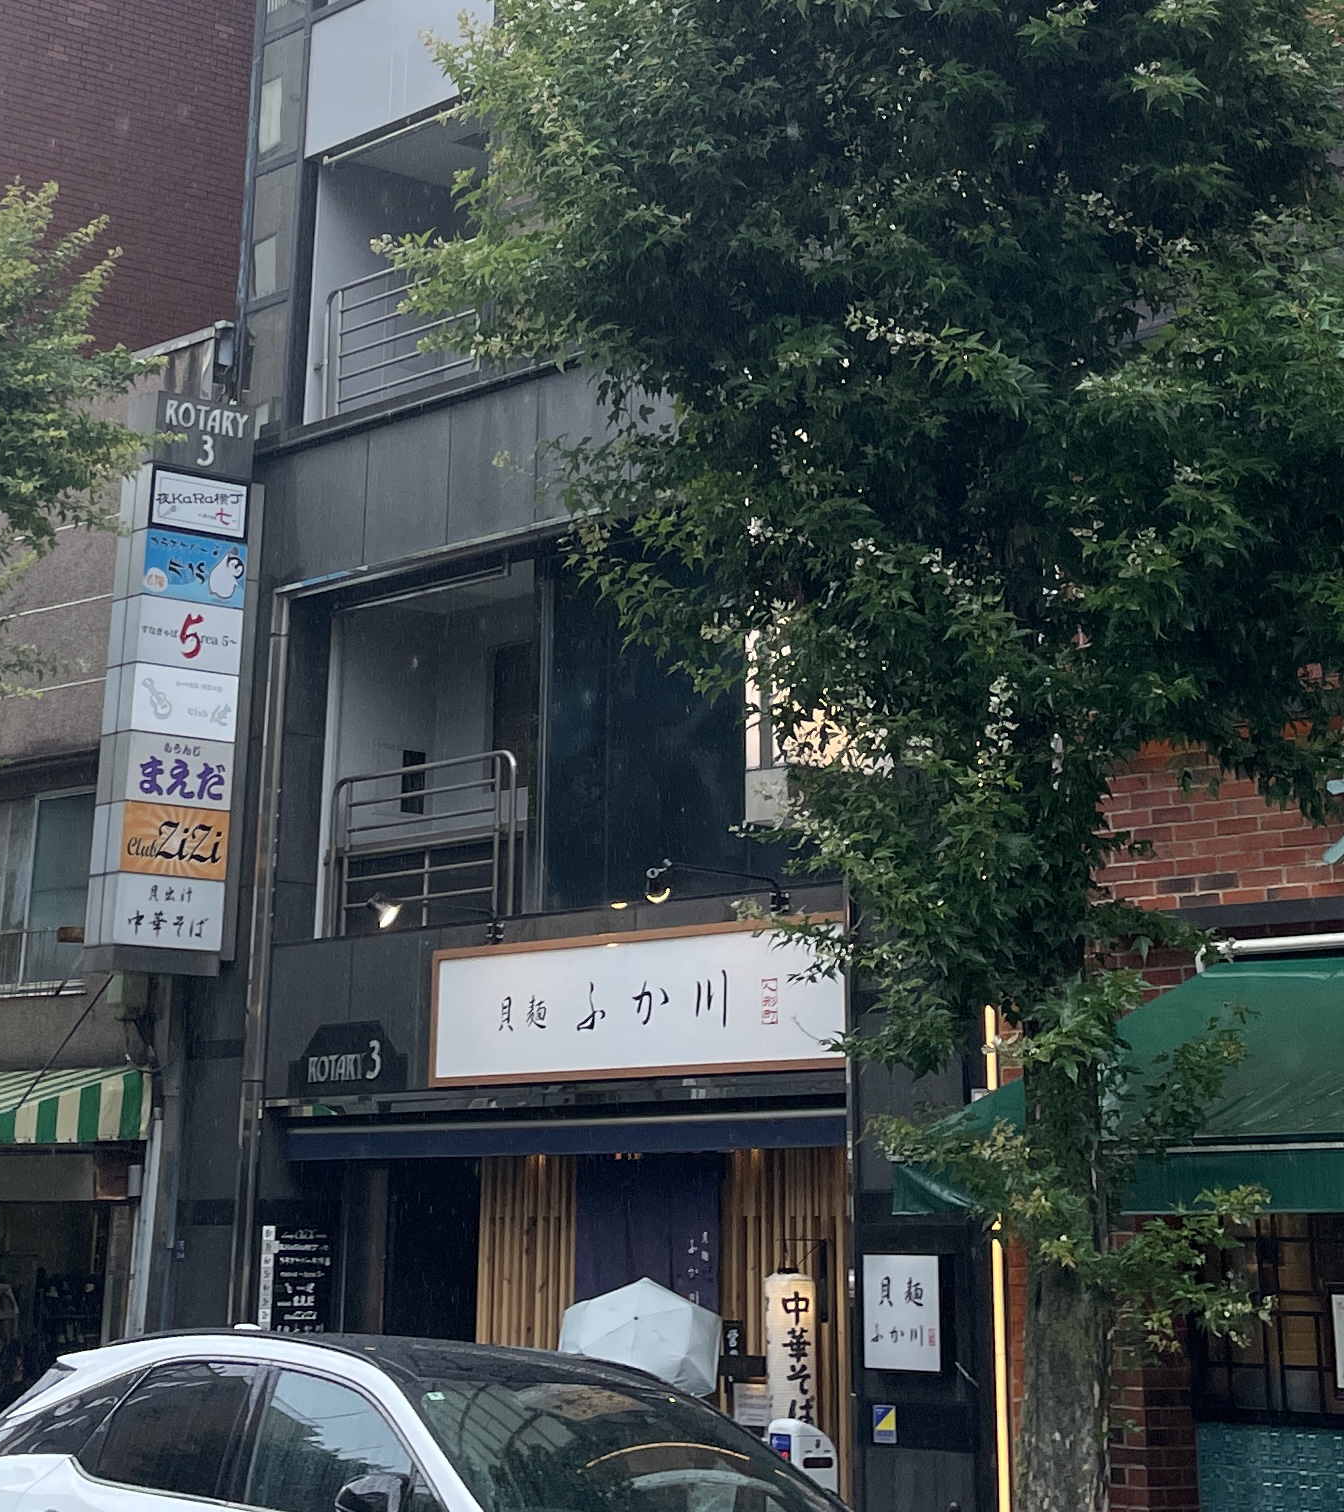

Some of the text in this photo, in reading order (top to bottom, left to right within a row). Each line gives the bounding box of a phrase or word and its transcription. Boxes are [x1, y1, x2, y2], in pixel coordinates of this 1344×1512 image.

[165, 399, 249, 438] ROTARY
[197, 435, 214, 466] 3
[180, 613, 204, 659] 5
[140, 756, 226, 801] まえだ
[127, 820, 223, 864] Club ZiZi
[127, 909, 209, 938] 中華そば
[498, 969, 728, 1032] 貝麺 ふか川
[366, 1039, 381, 1079] 3
[782, 1291, 815, 1423] 中華そば
